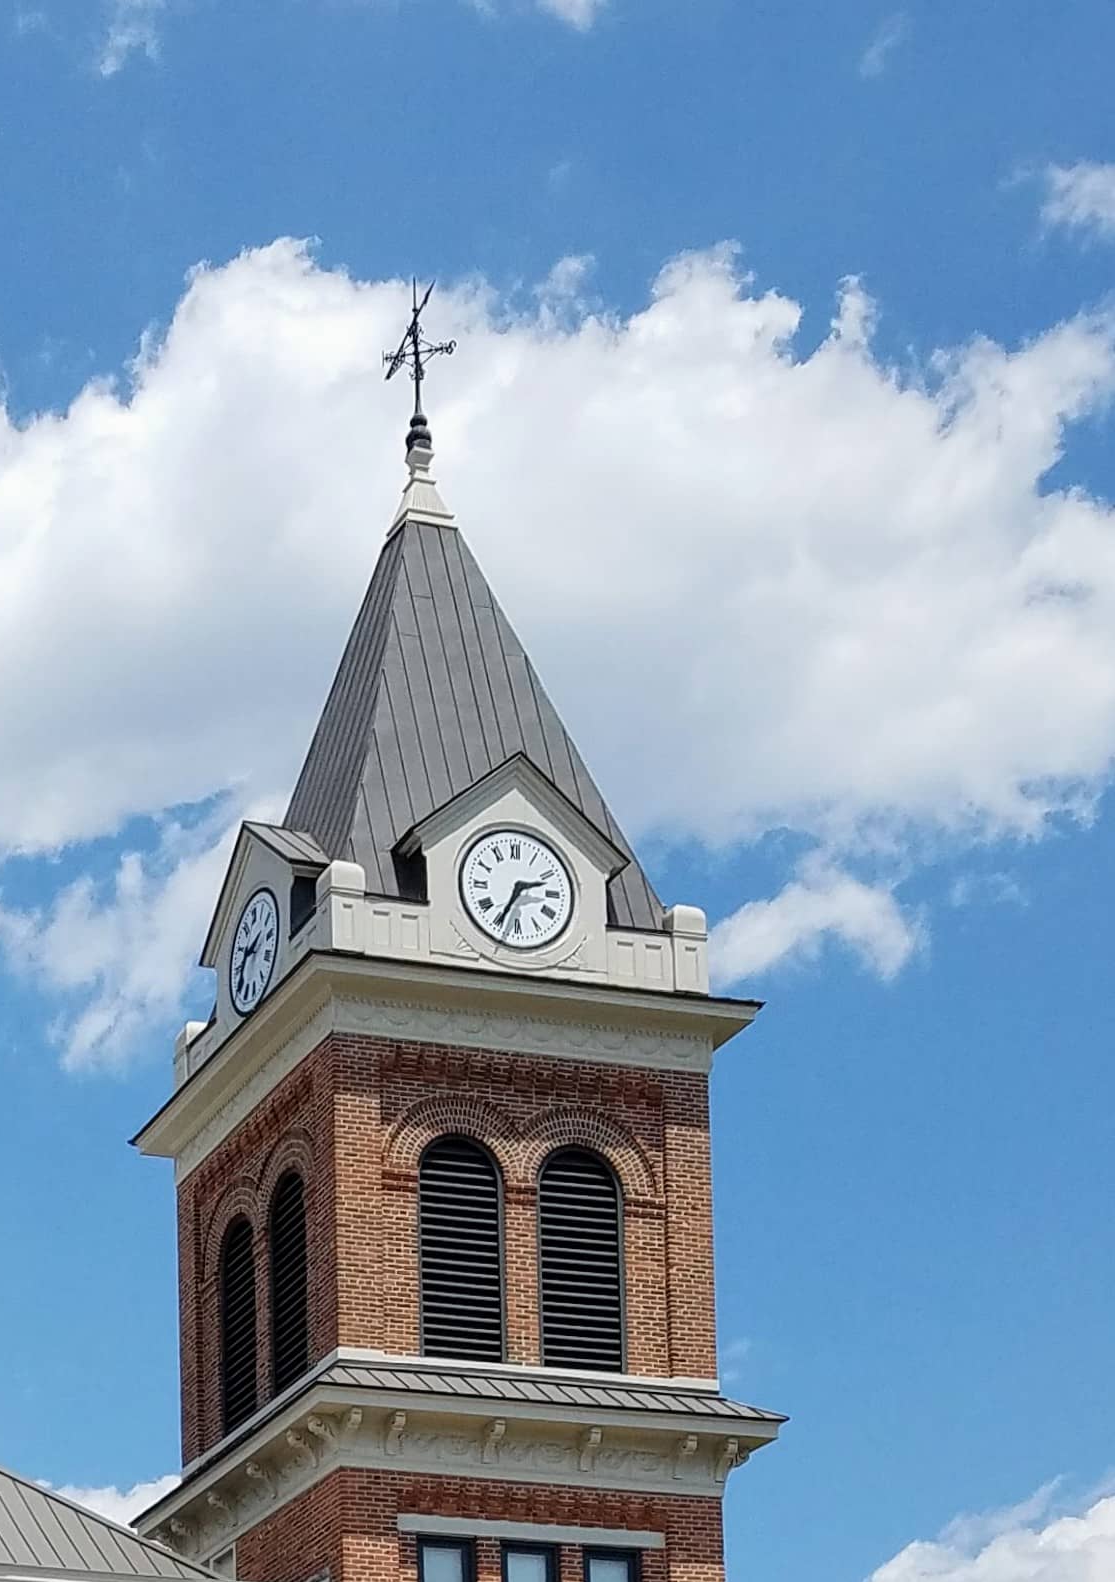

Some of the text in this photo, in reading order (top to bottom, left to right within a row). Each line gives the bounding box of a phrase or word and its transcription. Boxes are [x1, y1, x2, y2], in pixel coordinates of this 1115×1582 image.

[491, 845, 504, 863] XI
[510, 843, 521, 860] XII
[529, 852, 538, 866] I
[477, 860, 492, 873] X
[539, 869, 555, 880] II
[473, 880, 488, 889] IX
[545, 890, 560, 899] III
